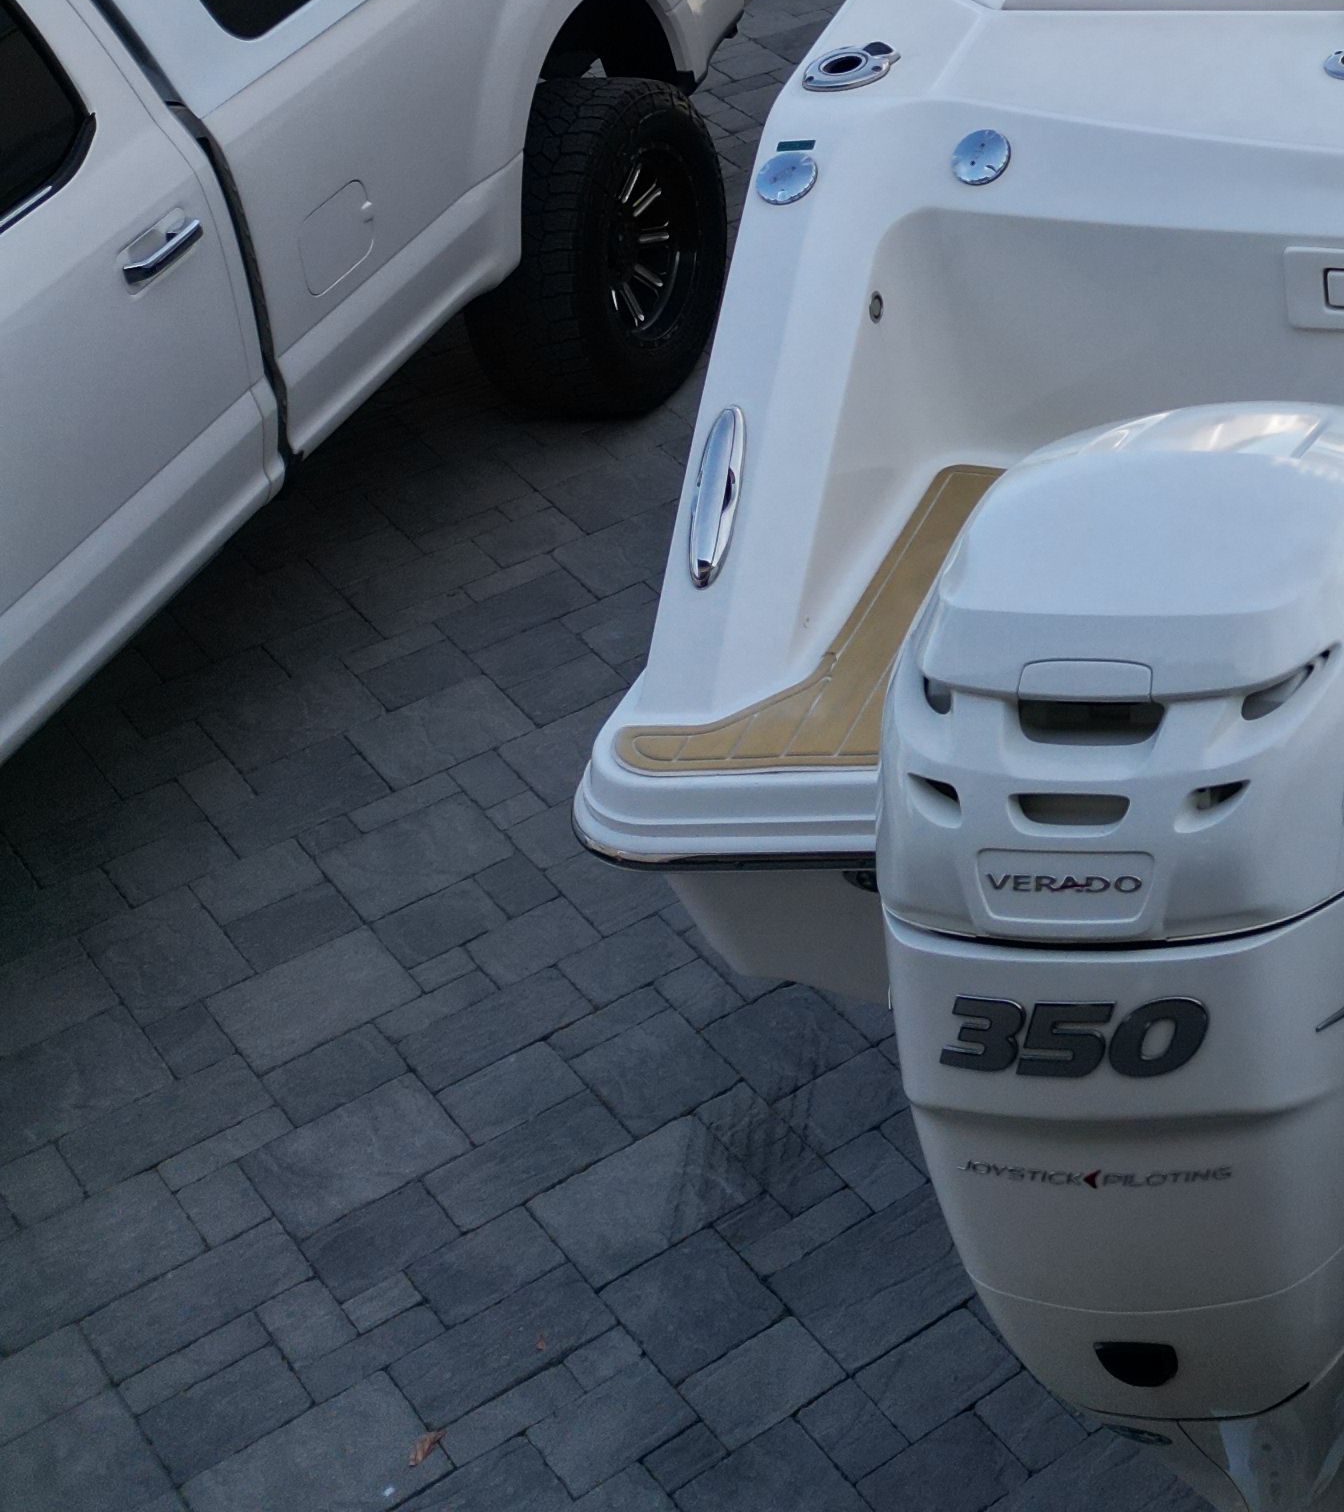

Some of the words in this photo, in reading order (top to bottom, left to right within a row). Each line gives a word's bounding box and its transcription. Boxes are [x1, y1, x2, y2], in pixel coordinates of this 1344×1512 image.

[985, 872, 1143, 894] VERADO
[939, 994, 1210, 1079] 350
[957, 1159, 1084, 1186] JOYSTICK
[1101, 1165, 1233, 1188] PILOTING
